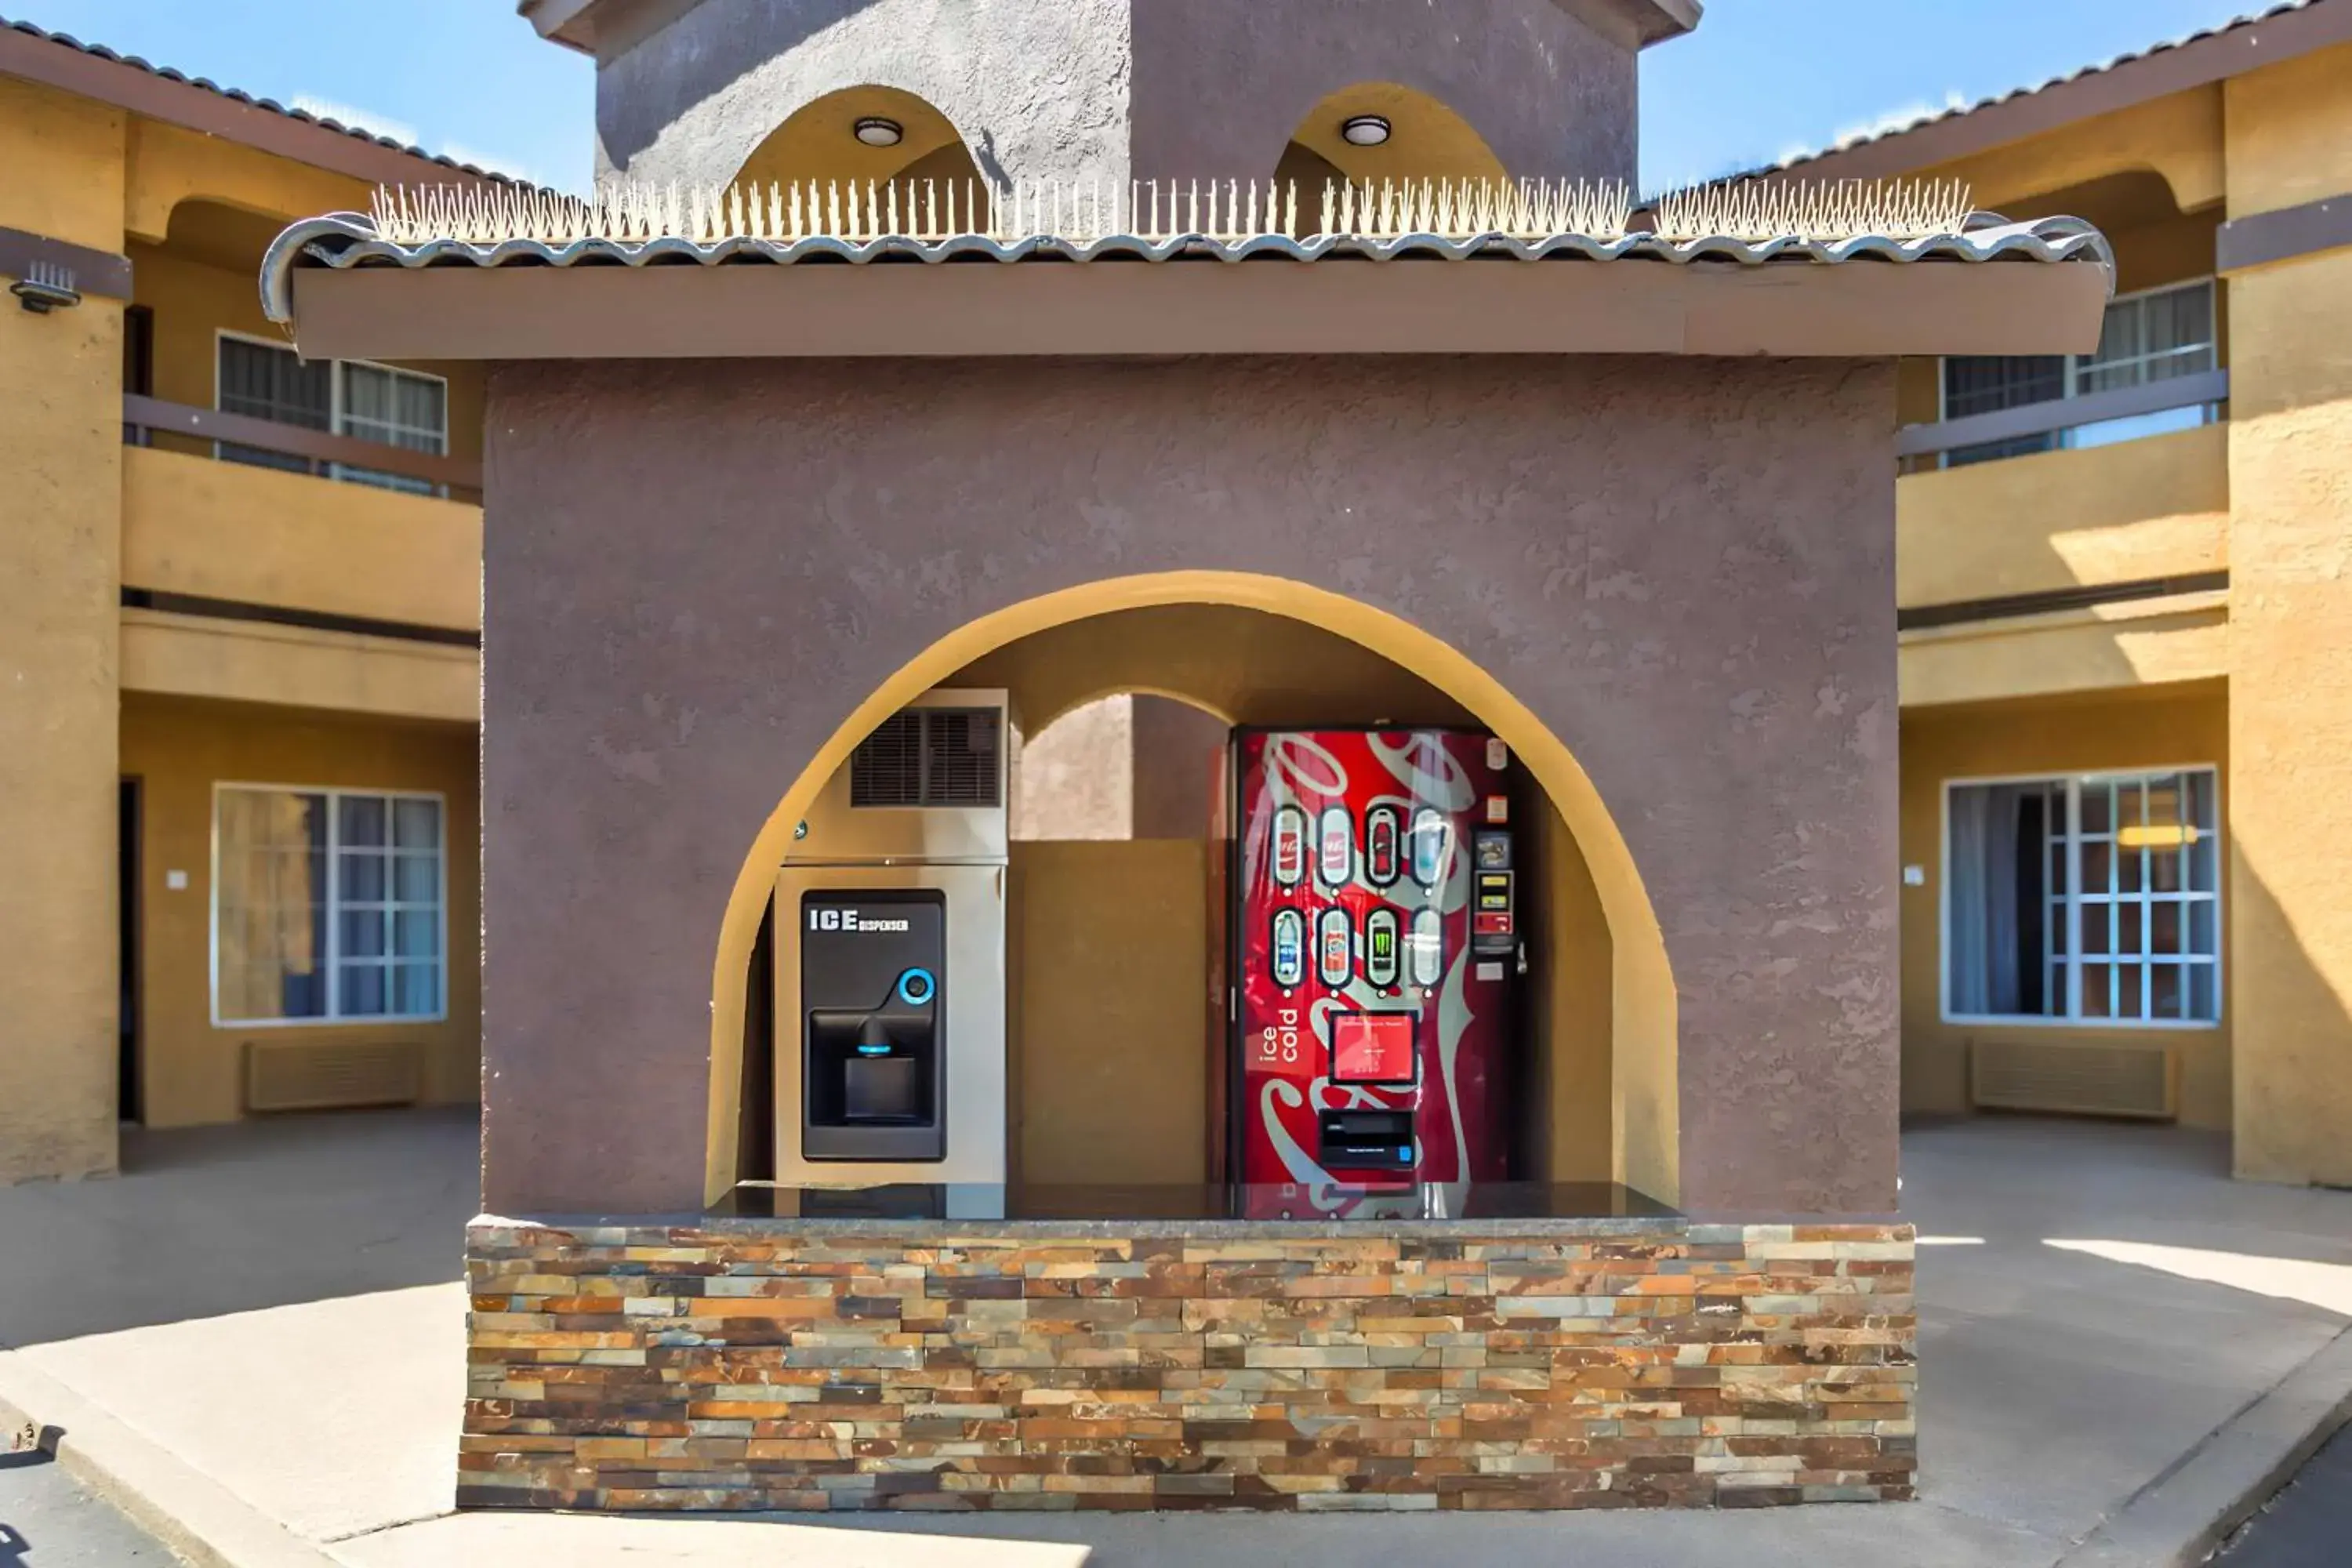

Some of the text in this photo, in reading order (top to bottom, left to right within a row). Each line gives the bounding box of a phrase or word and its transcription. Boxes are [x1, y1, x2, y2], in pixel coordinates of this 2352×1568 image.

[810, 909, 858, 931] ICE
[1259, 1026, 1277, 1062] ice
[1278, 1009, 1298, 1063] cold
